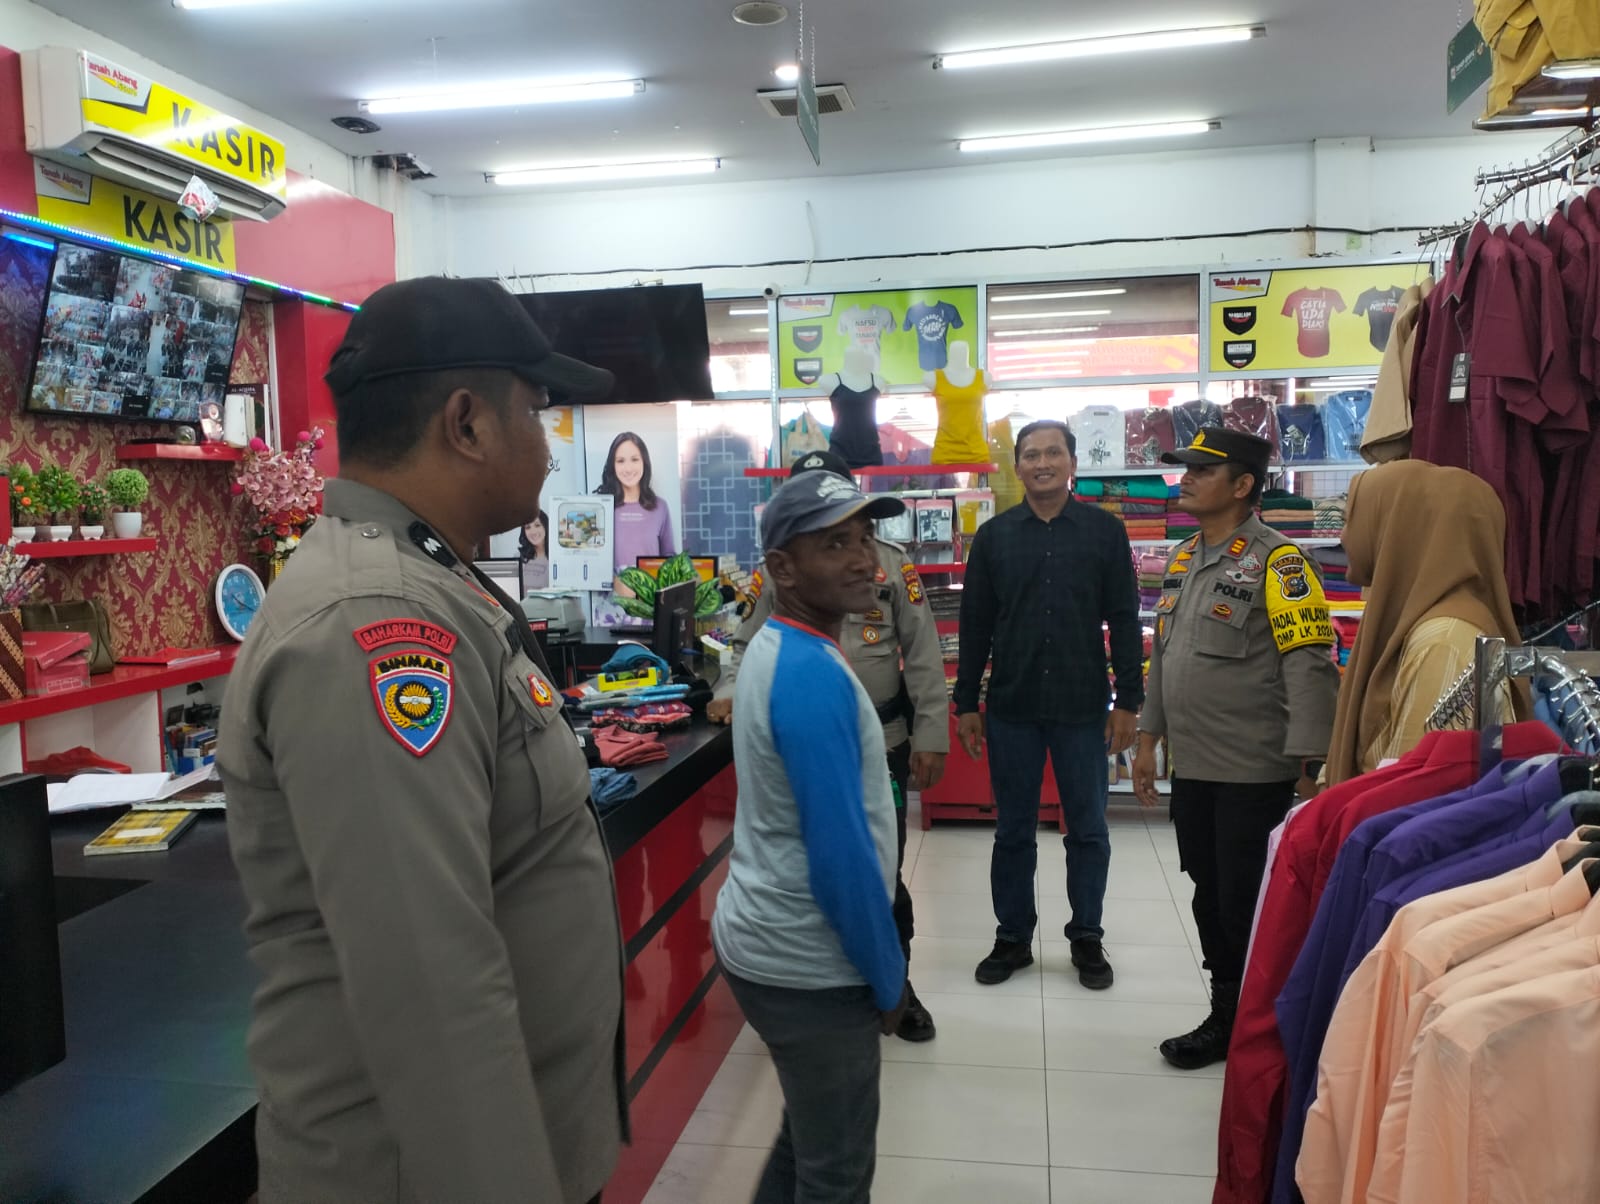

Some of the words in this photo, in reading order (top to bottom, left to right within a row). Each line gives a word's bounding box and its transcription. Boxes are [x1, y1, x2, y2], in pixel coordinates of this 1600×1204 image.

[112, 69, 138, 90] Abang
[172, 101, 276, 181] KASIR
[123, 194, 224, 264] KASIR
[1213, 582, 1253, 602] POLRI
[1272, 611, 1297, 632] PADAL
[1300, 626, 1313, 638] LK
[362, 623, 422, 645] BAHARKAM
[423, 628, 450, 648] POLRI
[377, 654, 445, 673] BINMAS
